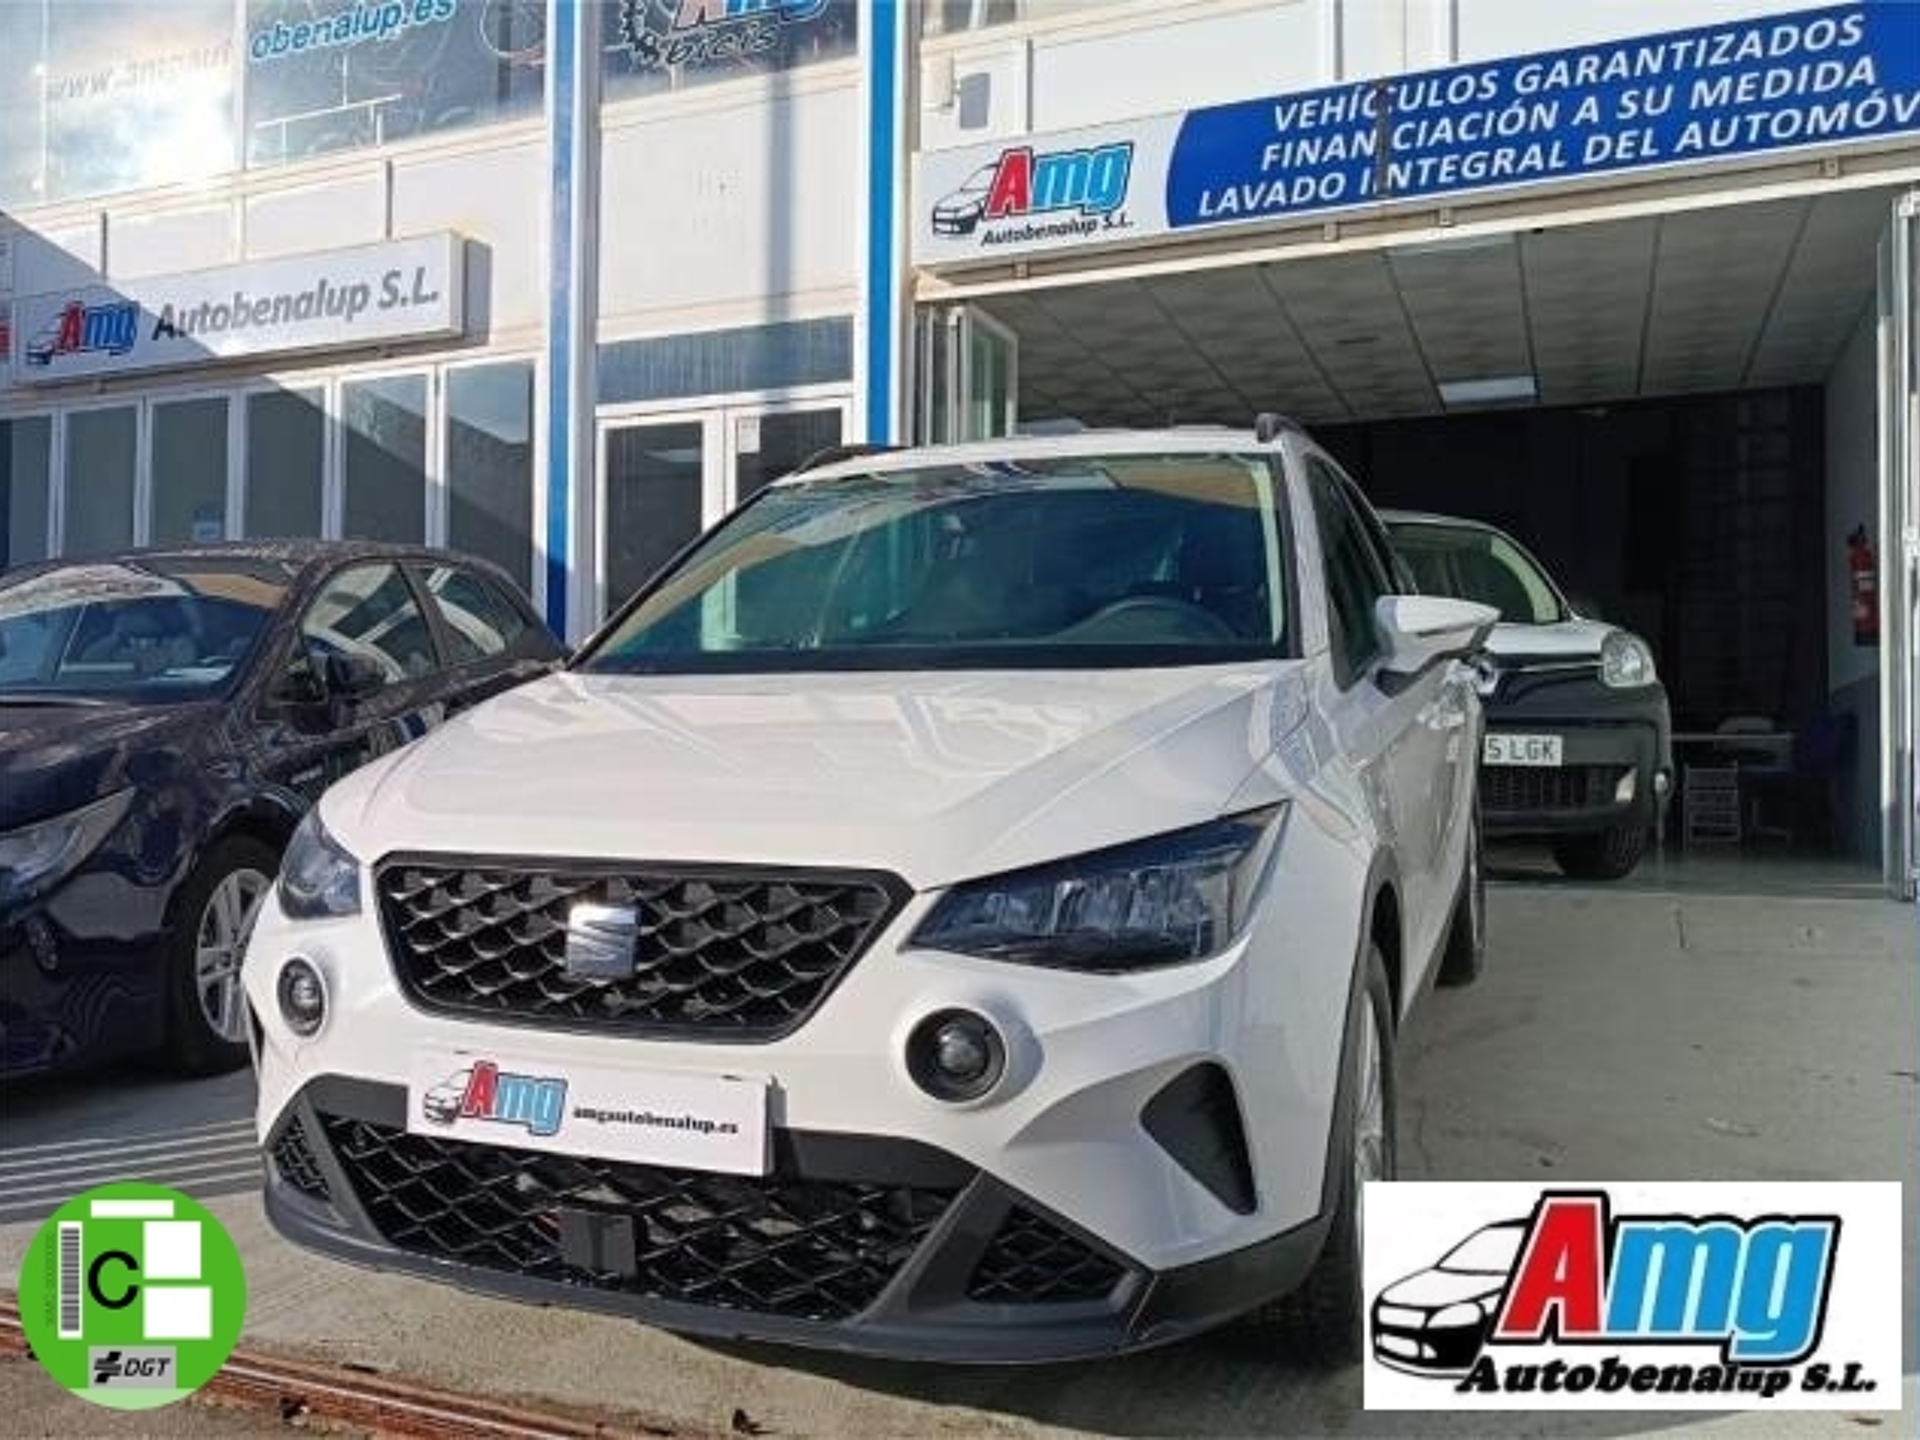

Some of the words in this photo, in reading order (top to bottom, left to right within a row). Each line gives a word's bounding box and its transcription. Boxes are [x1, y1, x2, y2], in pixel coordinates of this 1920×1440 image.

[1261, 100, 1559, 172] FINANCIACIÓN
[1571, 96, 1600, 126] A
[1615, 84, 1675, 120] SU
[1689, 56, 1876, 111] MEDIDA
[1274, 70, 1499, 132] VEHÍCULOS
[1514, 14, 1865, 94] GARANTIZADOS
[983, 139, 1137, 222] Amg
[1199, 172, 1346, 217] LAVADO
[1360, 140, 1568, 195] INTEGRAL
[1581, 127, 1660, 166] DEL
[981, 217, 1099, 246] Autobenalup
[1102, 212, 1135, 230] S.L.
[52, 299, 140, 356] Amg
[152, 278, 371, 341] Autobenalup
[377, 266, 440, 309] S.L.
[1509, 737, 1553, 761] LGK
[459, 1060, 569, 1137] Amg
[573, 1107, 739, 1135] amgautobenalup.es
